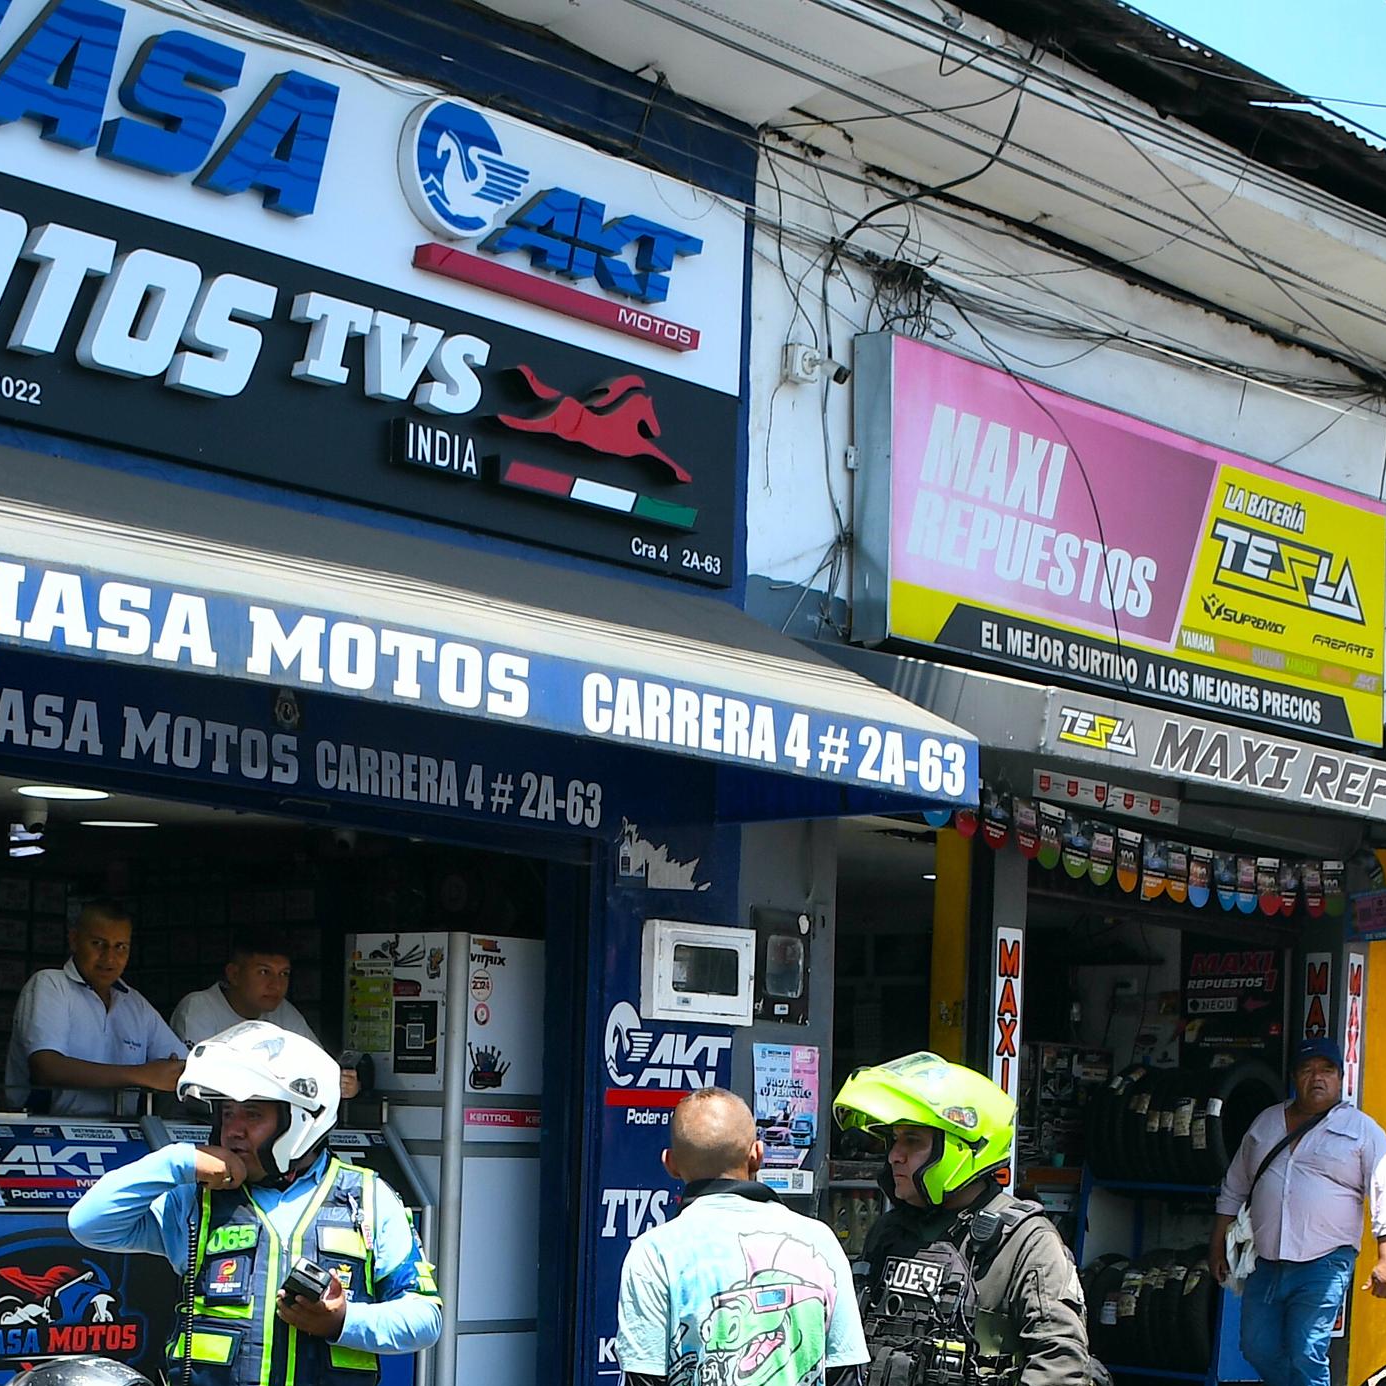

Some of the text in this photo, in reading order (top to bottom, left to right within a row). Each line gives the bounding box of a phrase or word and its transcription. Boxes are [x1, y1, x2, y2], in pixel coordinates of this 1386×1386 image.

[478, 187, 703, 304] AKT
[618, 308, 691, 345] MOTOS
[289, 291, 492, 417] TVS
[407, 422, 478, 476] INDIA
[919, 403, 1068, 519] MAXI
[1223, 482, 1245, 511] LA
[631, 537, 721, 575] Cra 4 2A-63
[905, 488, 1157, 619] REPUESTOS
[1181, 630, 1215, 653] YAMAHA
[981, 621, 1321, 725] EL MEJOR SURTIDO A LOS MEJORES PRECIOS
[246, 606, 530, 719] MOTOS
[582, 670, 778, 765] CARRERA
[780, 711, 812, 768] 4
[818, 726, 850, 775] #
[857, 724, 967, 796] 2A-63
[120, 706, 299, 785] MOTOS
[316, 739, 461, 809] CARRERA
[462, 765, 484, 810] 4
[490, 774, 514, 813] #
[519, 772, 603, 830] 2A-63
[1152, 719, 1299, 792] MAXI
[1187, 978, 1263, 989] REPUESTOS
[996, 938, 1021, 1092] MAXI
[636, 1033, 731, 1088] AKT
[627, 1108, 669, 1126] Poder a
[12, 1188, 53, 1201] Poder
[56, 1192, 64, 1200] a
[601, 1189, 668, 1237] TVS
[207, 1225, 257, 1252] 065
[884, 1261, 938, 1293] GOES
[46, 1323, 138, 1354] MOTOS
